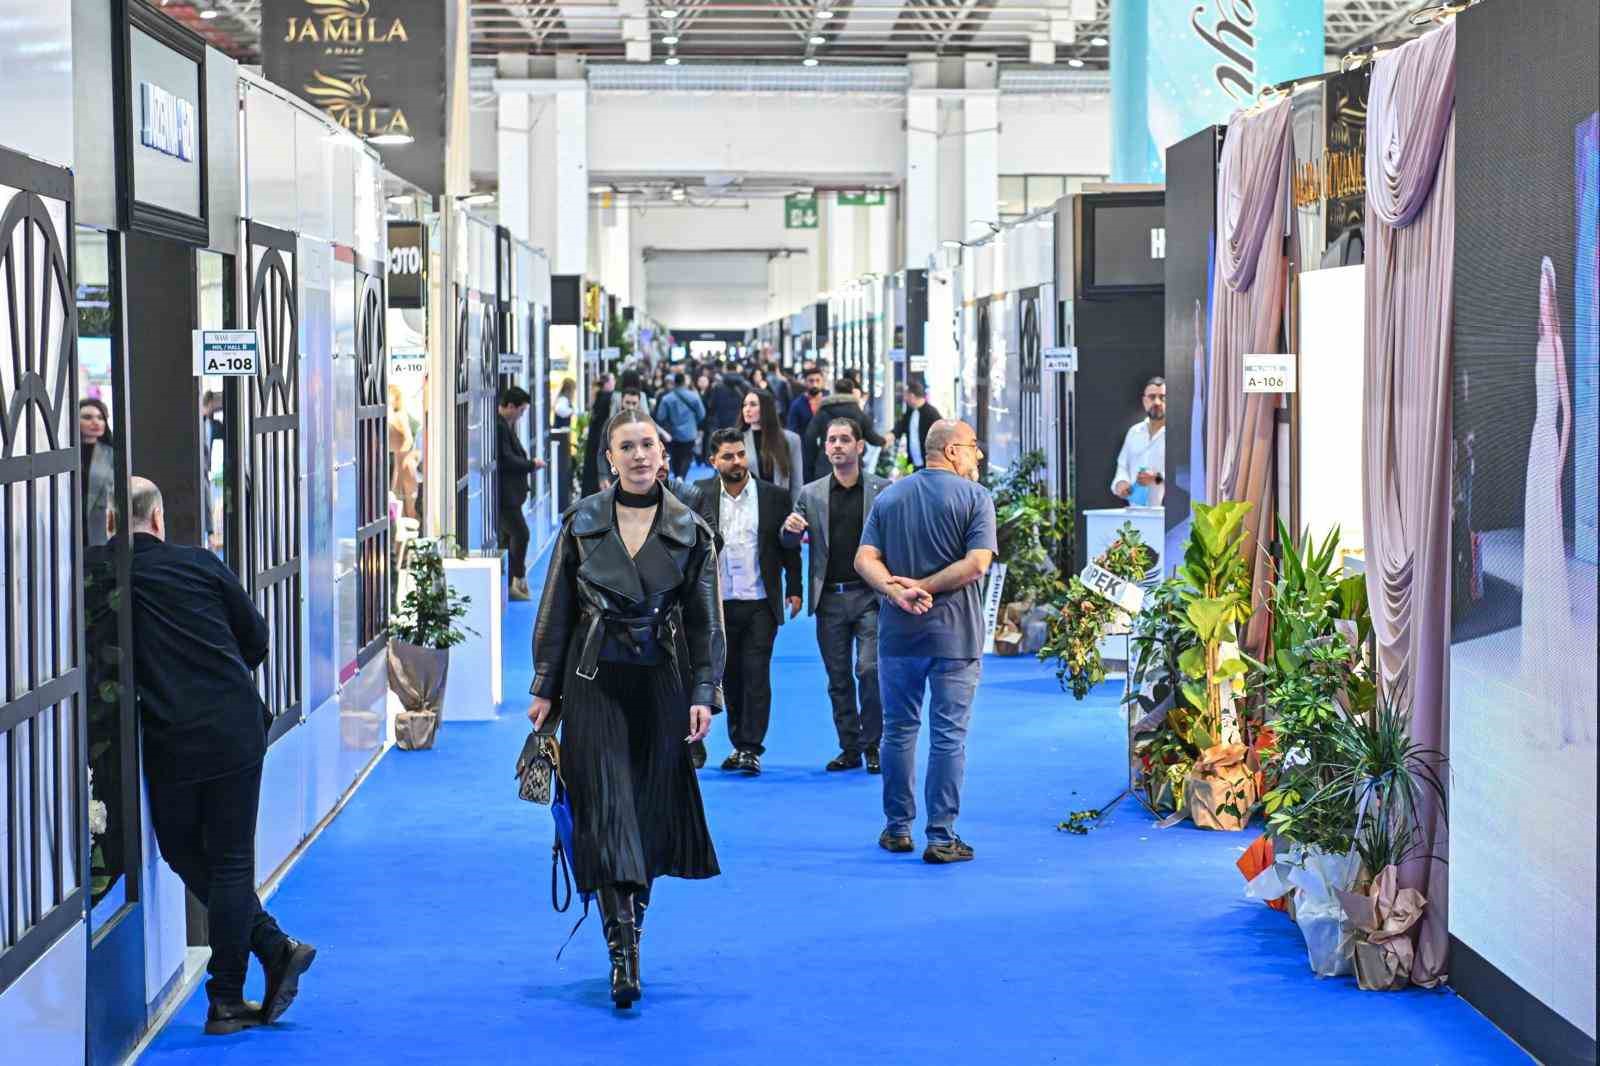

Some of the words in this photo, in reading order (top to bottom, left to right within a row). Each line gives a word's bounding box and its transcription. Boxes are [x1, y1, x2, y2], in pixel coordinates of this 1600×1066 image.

[284, 17, 409, 42] JAMILA
[207, 358, 253, 370] A-108
[1248, 377, 1284, 387] A-106
